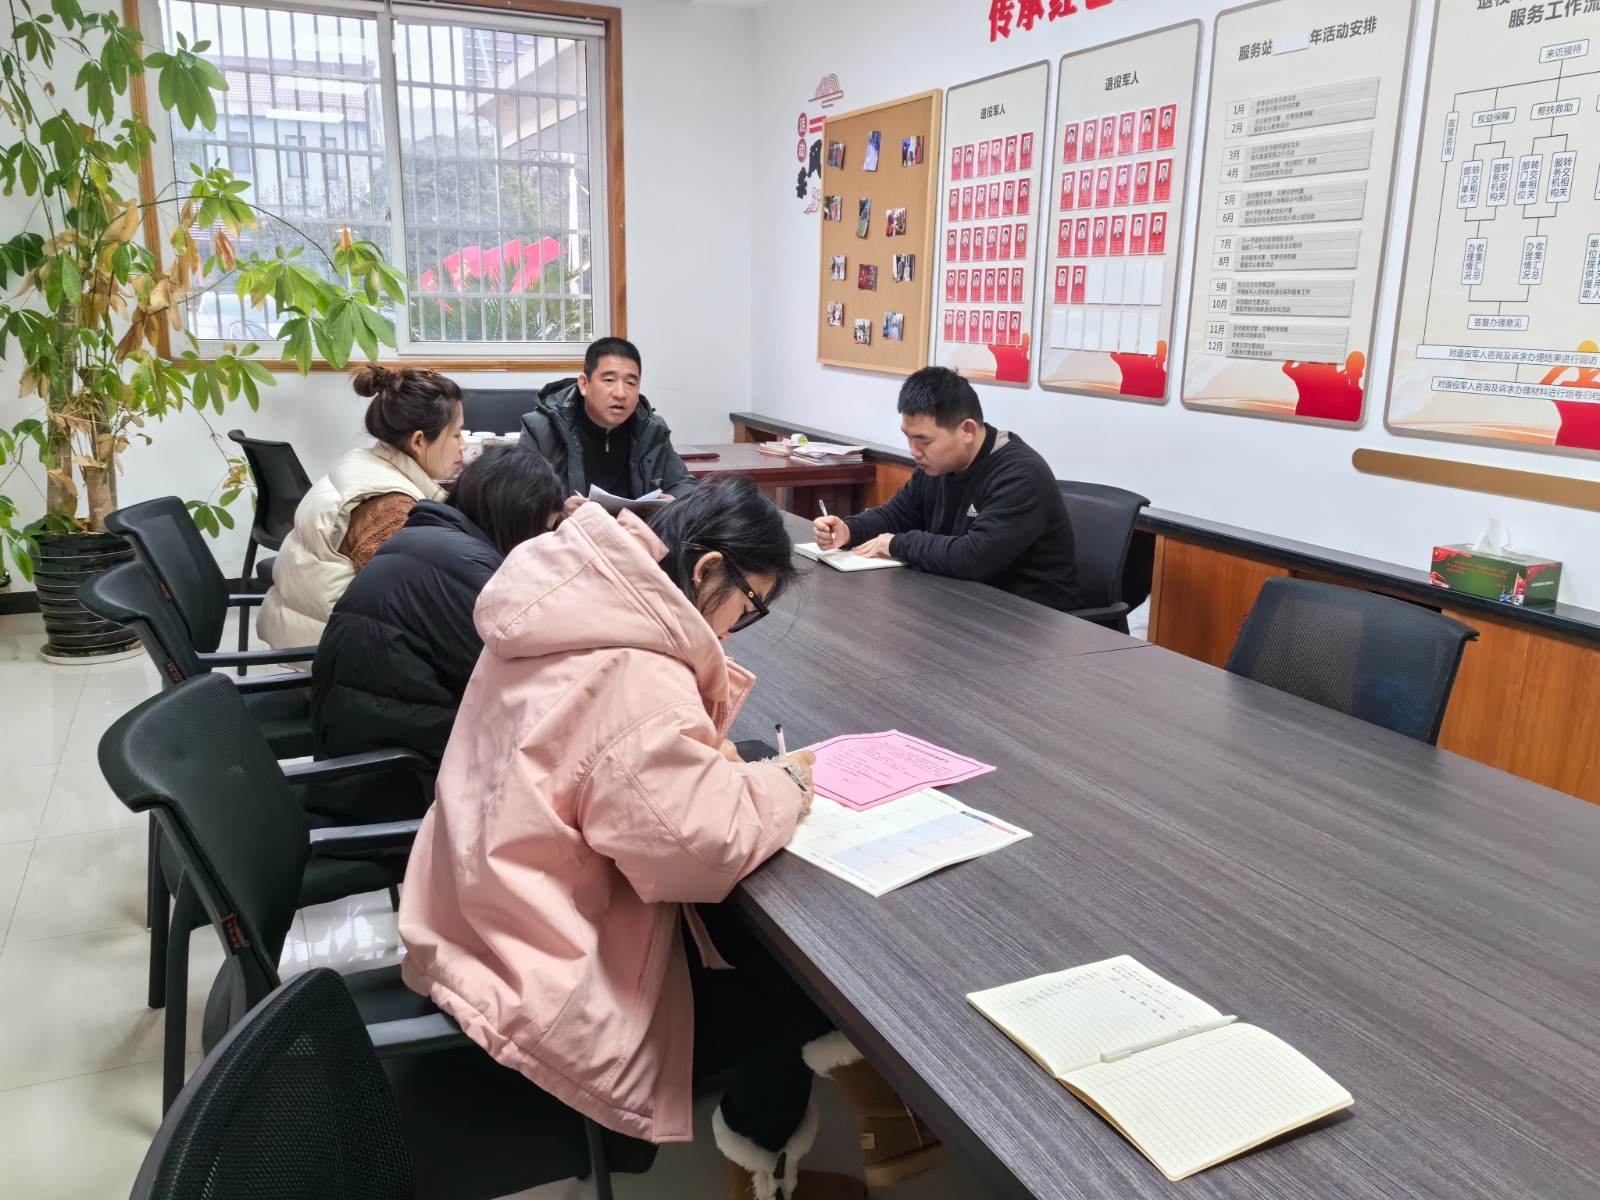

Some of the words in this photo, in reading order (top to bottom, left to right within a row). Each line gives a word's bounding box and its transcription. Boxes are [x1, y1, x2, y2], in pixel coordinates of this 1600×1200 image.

[1238, 39, 1273, 61] 服务站
[1309, 16, 1377, 45] 年活动安排
[1545, 44, 1582, 59] 来访接待
[1104, 71, 1139, 91] 退役军人
[980, 103, 1006, 120] 退役军人
[1232, 104, 1245, 115] 1月
[1477, 111, 1510, 124] 权益保障
[1537, 102, 1574, 116] 帮扶救助
[1231, 122, 1243, 134] 2月
[1444, 119, 1456, 156] 政策咨询
[1229, 150, 1240, 161] 3月
[1226, 168, 1239, 178] 4月
[1517, 161, 1530, 200] 部门单位
[1527, 160, 1540, 199] 转交相关
[1550, 158, 1563, 198] 服务机构
[1558, 157, 1573, 197] 转交相关
[1459, 166, 1471, 203] 部门单位
[1468, 165, 1480, 203] 转交相关
[1489, 164, 1501, 202] 服务机构
[1498, 163, 1510, 201] 转交相关
[1224, 194, 1235, 205] 5月
[1222, 212, 1234, 223] 6月
[1220, 239, 1231, 249] 7月
[1218, 256, 1230, 267] 8月
[1463, 243, 1476, 280] 办理情况
[1472, 243, 1485, 280] 收集汇总
[1521, 241, 1534, 280] 办理情况
[1531, 241, 1544, 280] 收集汇总
[1216, 282, 1227, 292] 9月
[1212, 299, 1227, 310] 10月
[1209, 325, 1225, 335] 11月
[1473, 317, 1522, 328] 答复办理意见
[1208, 341, 1223, 351] 12月
[1449, 348, 1597, 365] 对退役军人咨询及诉求办理结果进行回访
